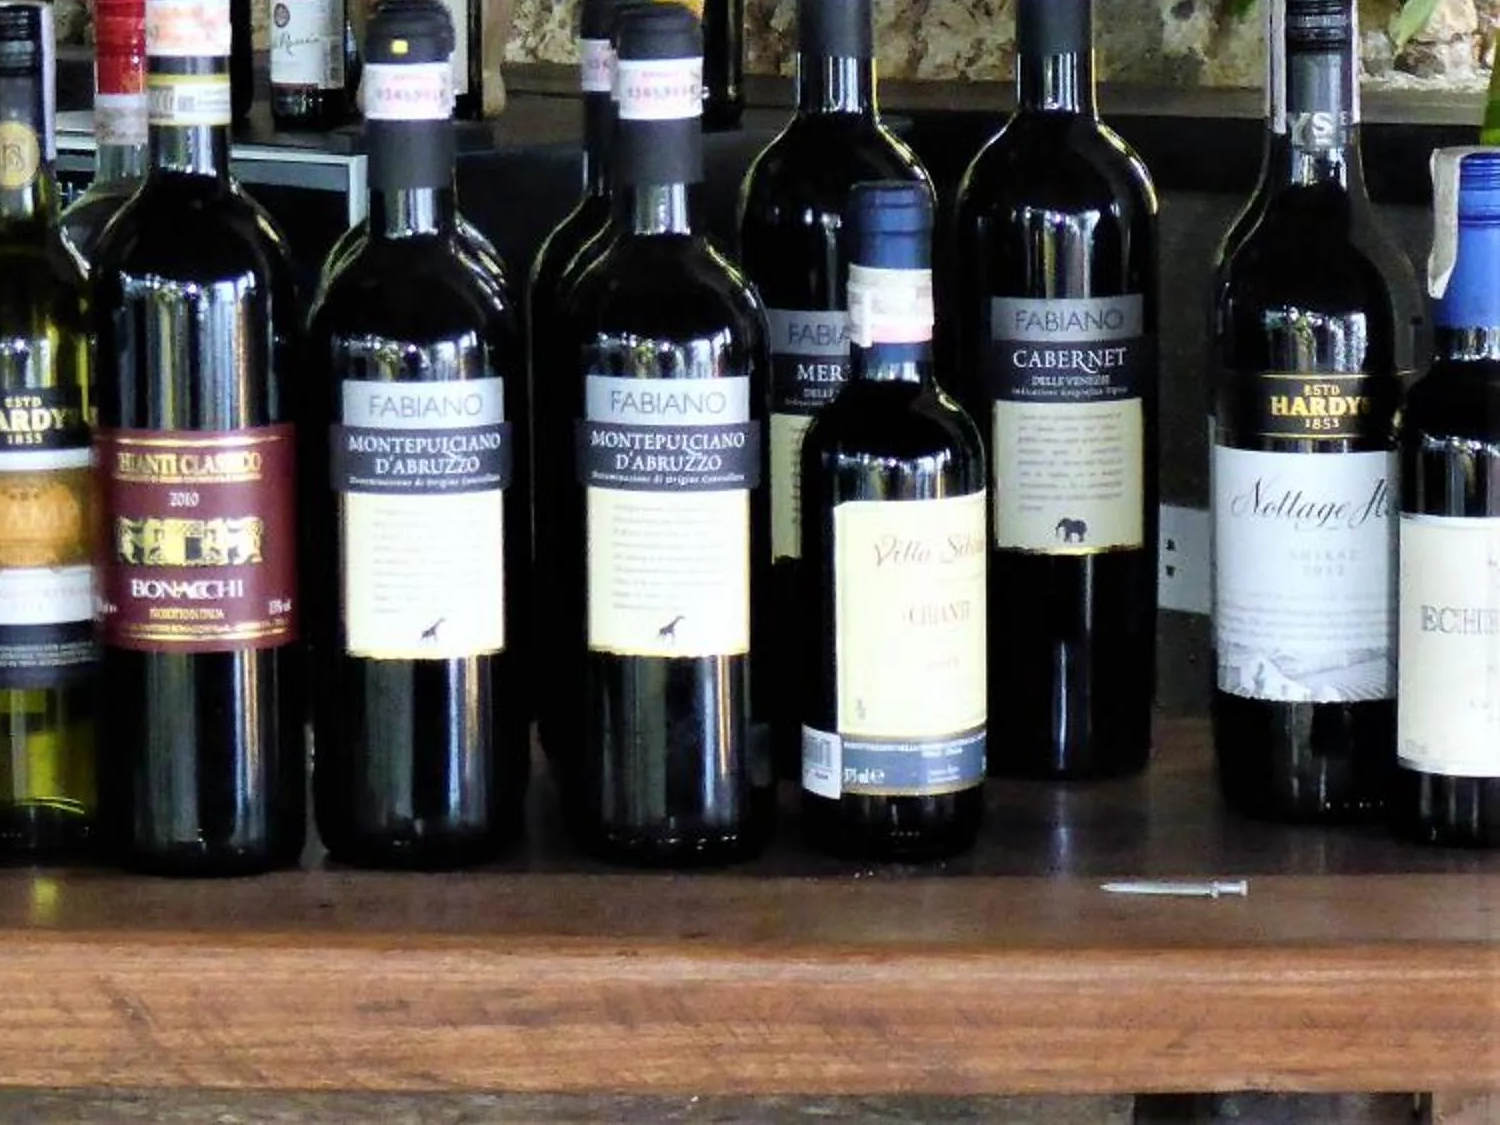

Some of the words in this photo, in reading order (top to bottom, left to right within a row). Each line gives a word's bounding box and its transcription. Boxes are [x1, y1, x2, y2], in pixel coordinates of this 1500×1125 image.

[1014, 308, 1124, 332] FABIANO
[1013, 346, 1127, 374] CABERNET
[797, 363, 849, 382] MER
[1304, 384, 1341, 396] ESTD
[368, 393, 484, 419] FABIANO
[611, 391, 727, 415] FABIANO
[1305, 418, 1340, 430] 1853
[349, 432, 501, 457] MONTEPULCIANO
[591, 430, 745, 455] MONTEPULCIANO
[375, 455, 481, 475] D'ABRUZZO
[615, 451, 723, 472] D'ABRUZZO
[168, 491, 200, 507] 2010
[1231, 475, 1350, 527] Nottage
[873, 533, 932, 568] Villa
[130, 578, 244, 600] BONACCHI
